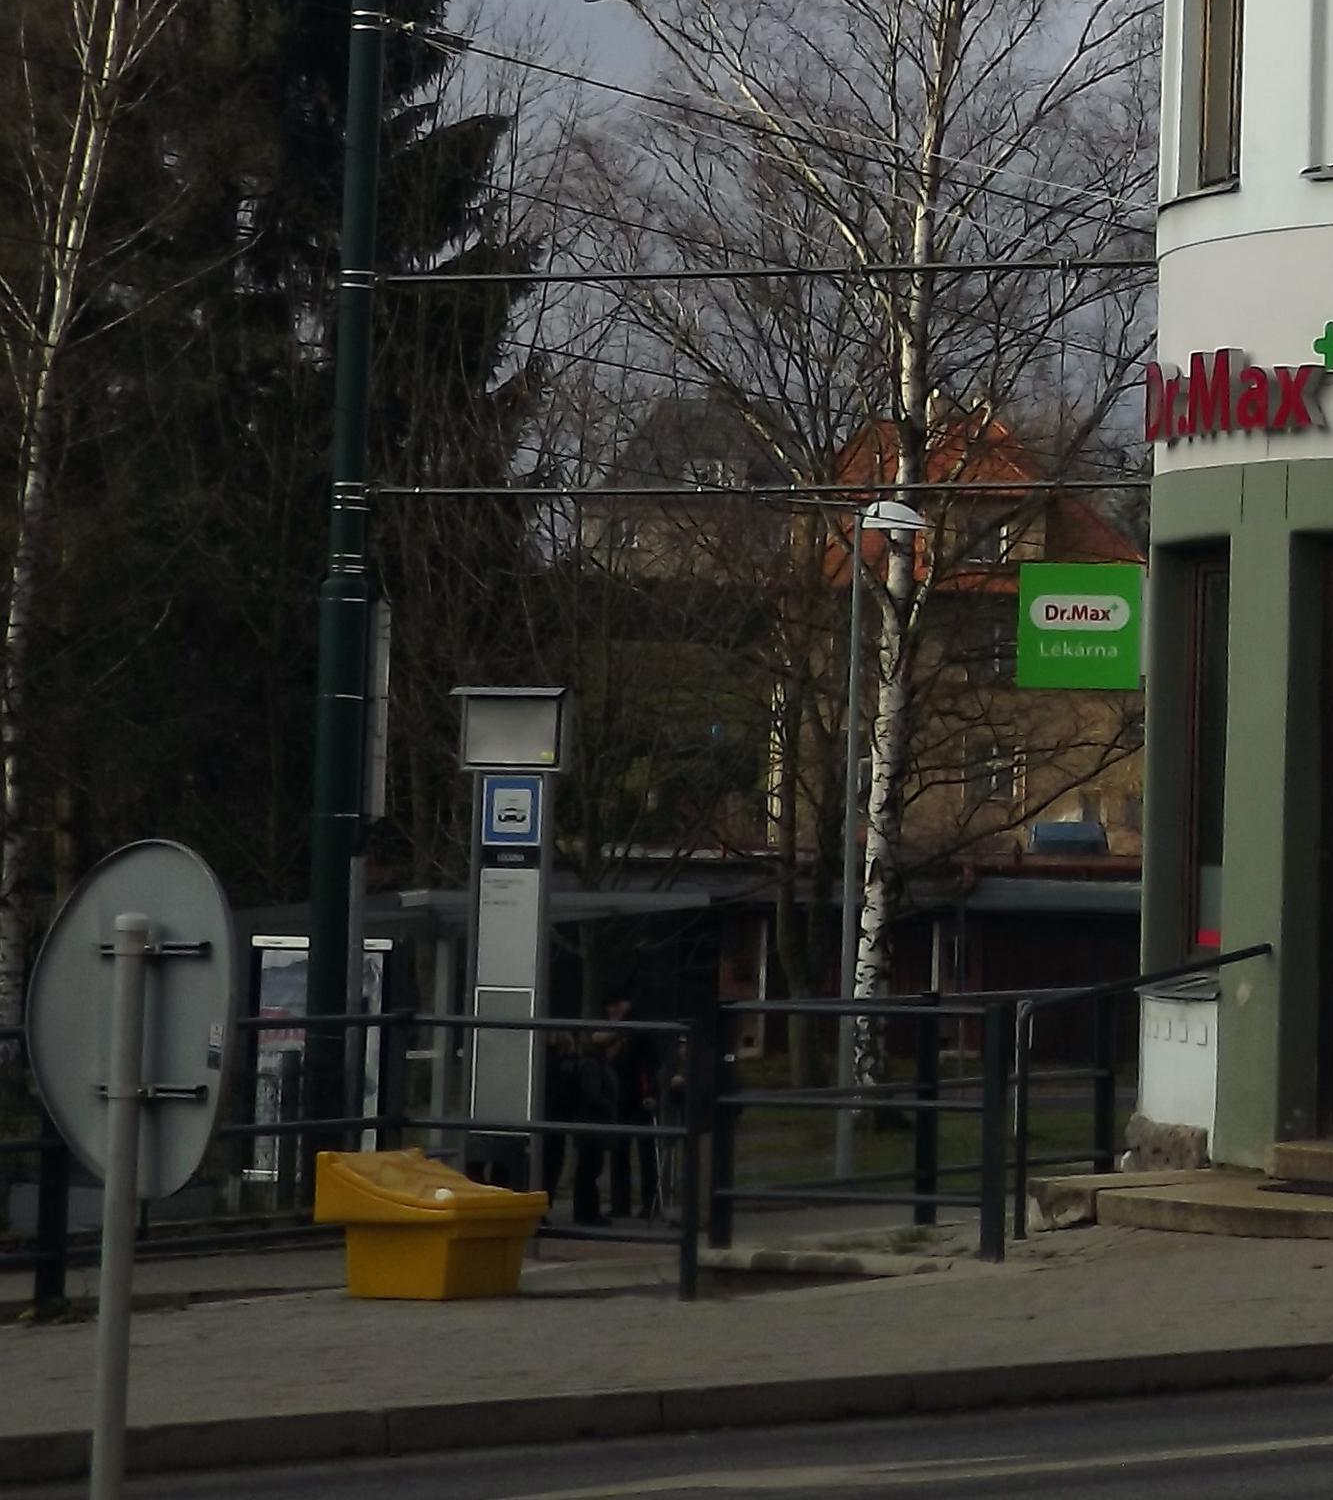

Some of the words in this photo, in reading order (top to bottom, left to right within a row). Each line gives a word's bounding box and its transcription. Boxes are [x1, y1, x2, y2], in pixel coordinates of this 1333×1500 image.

[1145, 348, 1326, 442] Dr.Max
[1044, 604, 1111, 622] Dr.Max
[1039, 640, 1119, 658] Lékárna
